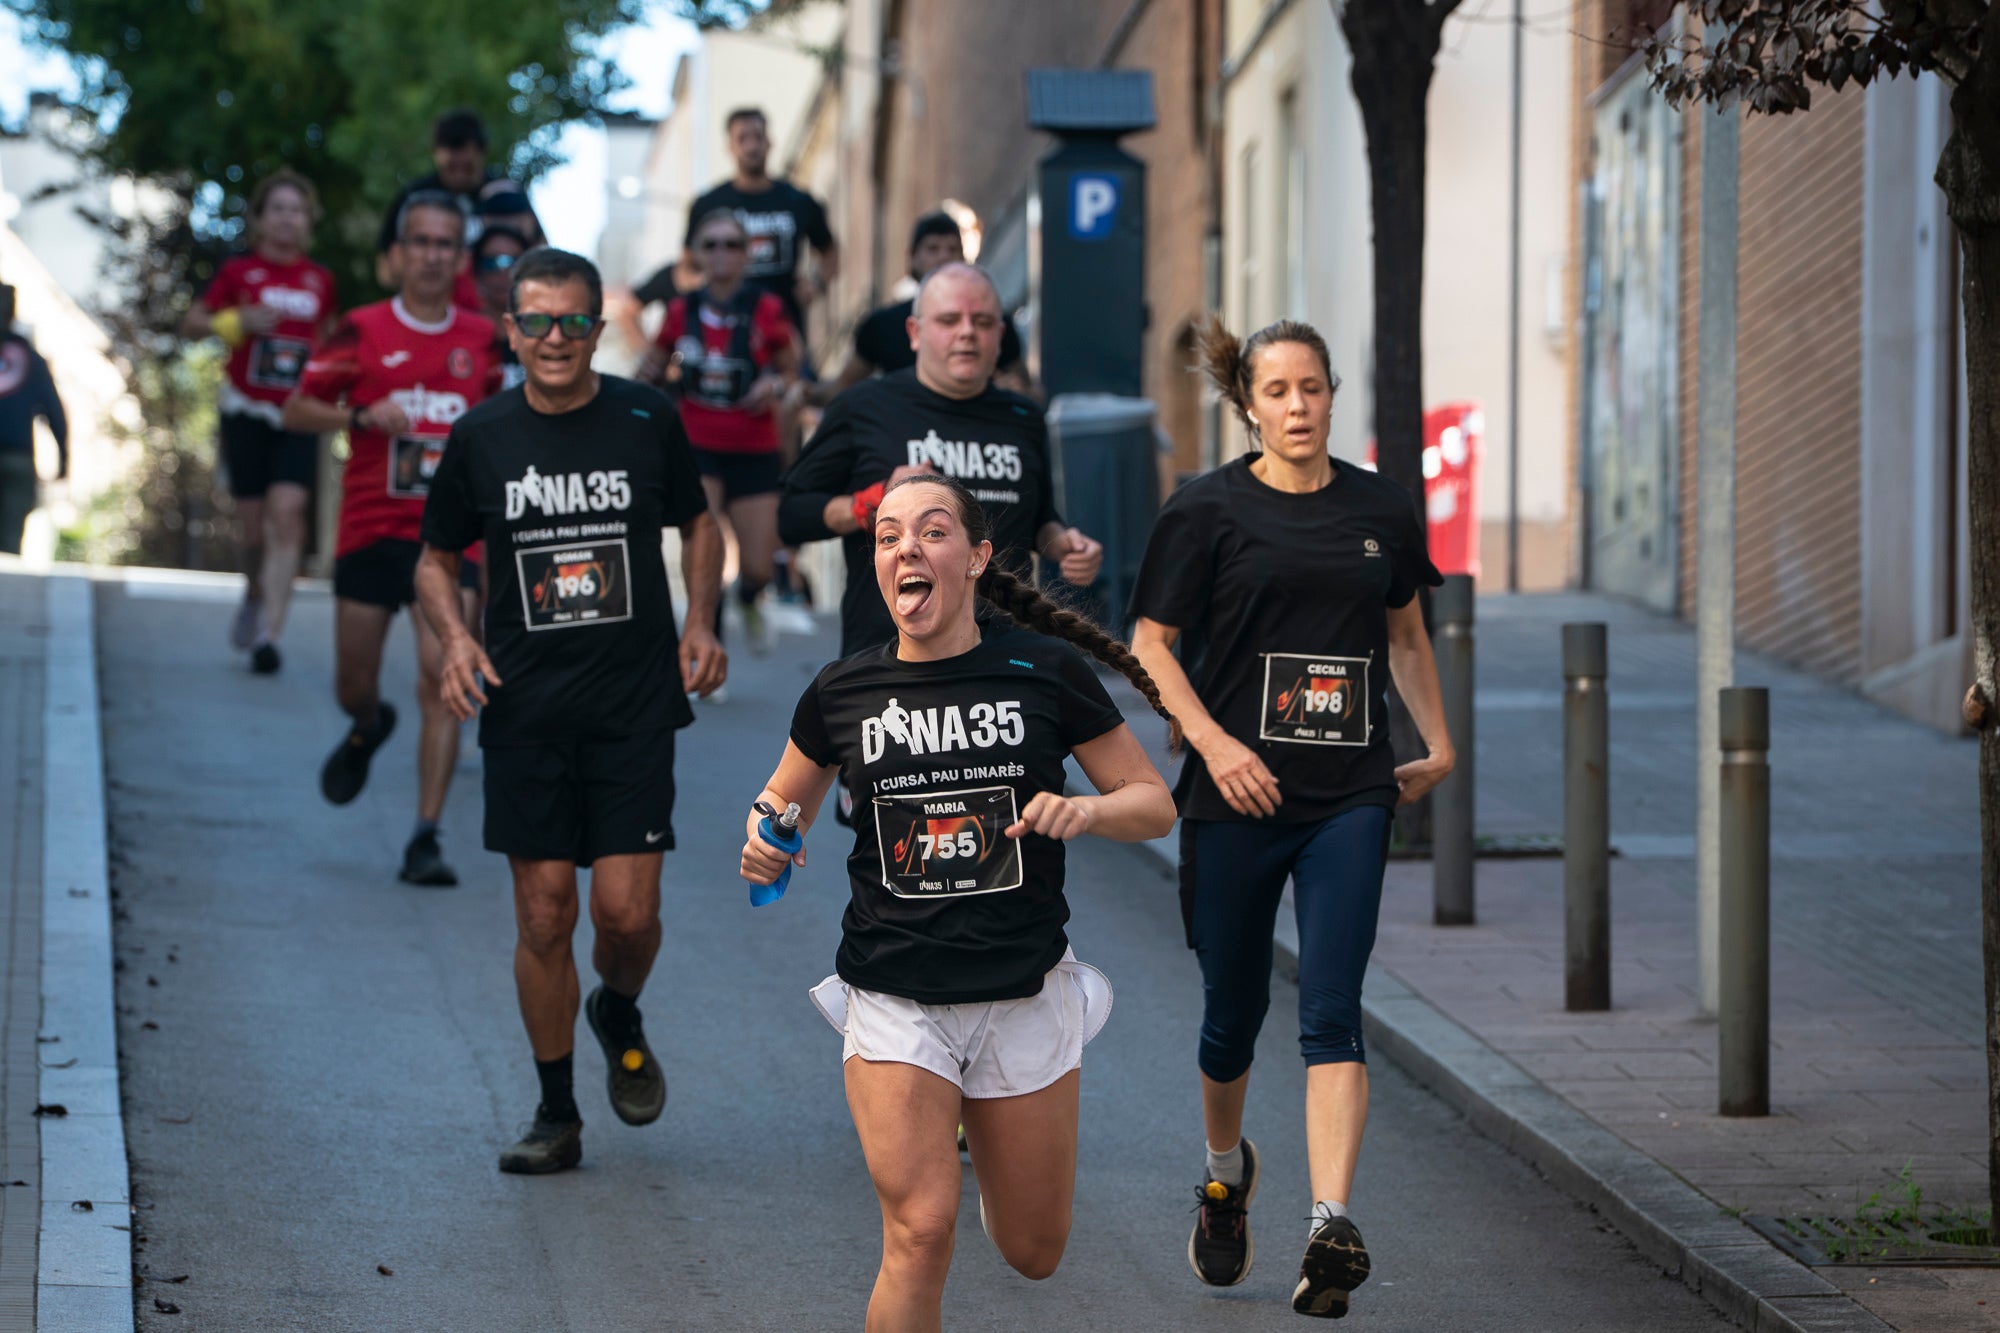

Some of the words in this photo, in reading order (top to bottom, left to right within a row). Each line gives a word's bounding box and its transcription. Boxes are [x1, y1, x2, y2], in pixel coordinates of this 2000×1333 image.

[1075, 178, 1116, 232] P
[556, 525, 579, 539] PAU
[553, 550, 593, 564] ROMAN
[555, 574, 596, 599] 196
[1307, 663, 1347, 676] CECILIA
[1304, 689, 1343, 714] 198
[880, 772, 928, 791] CURSA
[931, 767, 959, 783] PAU
[963, 761, 1025, 780] DINARÈS
[923, 801, 967, 815] MARIA
[918, 831, 977, 861] 755
